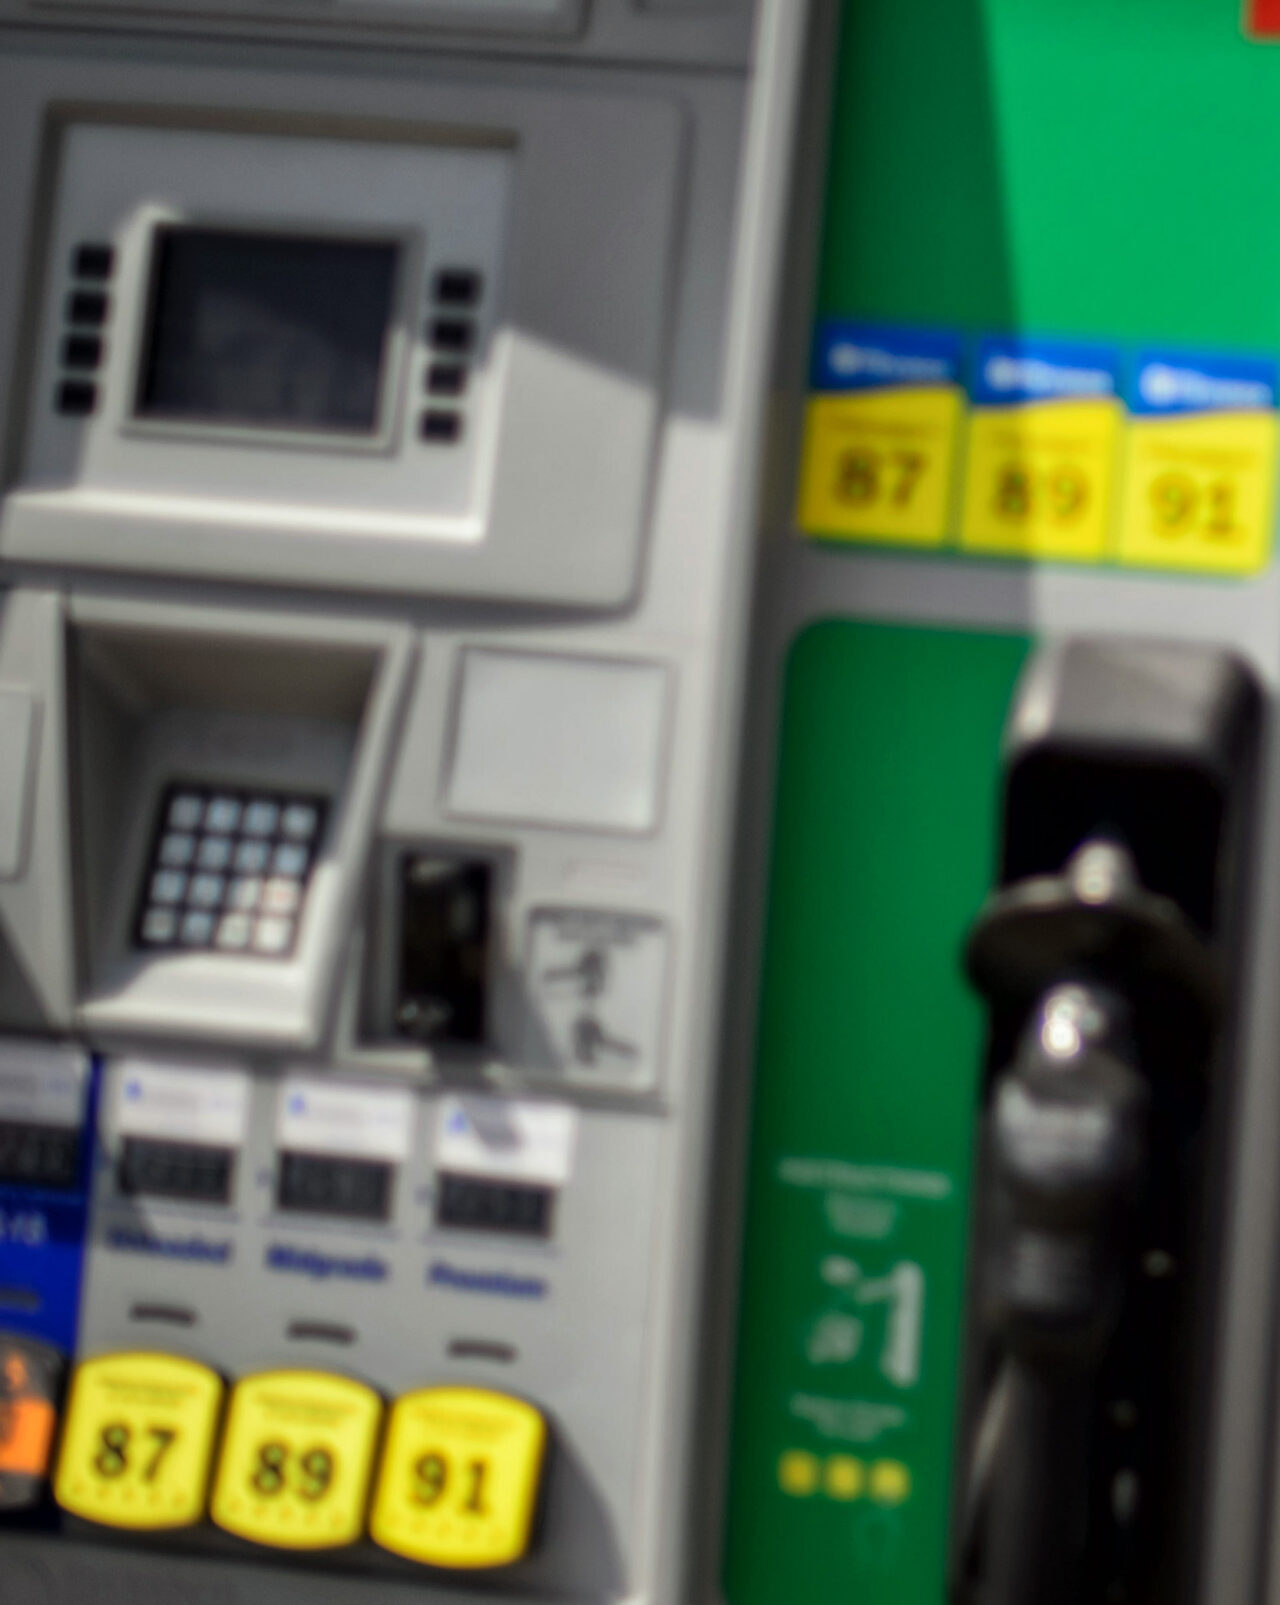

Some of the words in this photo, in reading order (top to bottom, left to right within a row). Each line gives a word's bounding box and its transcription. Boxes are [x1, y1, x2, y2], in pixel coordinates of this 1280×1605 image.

[834, 447, 928, 510] 87
[992, 462, 1092, 530] 89
[1148, 471, 1249, 545] 91
[91, 1421, 178, 1484] 87
[250, 1440, 335, 1501] 89
[410, 1451, 492, 1517] 91
